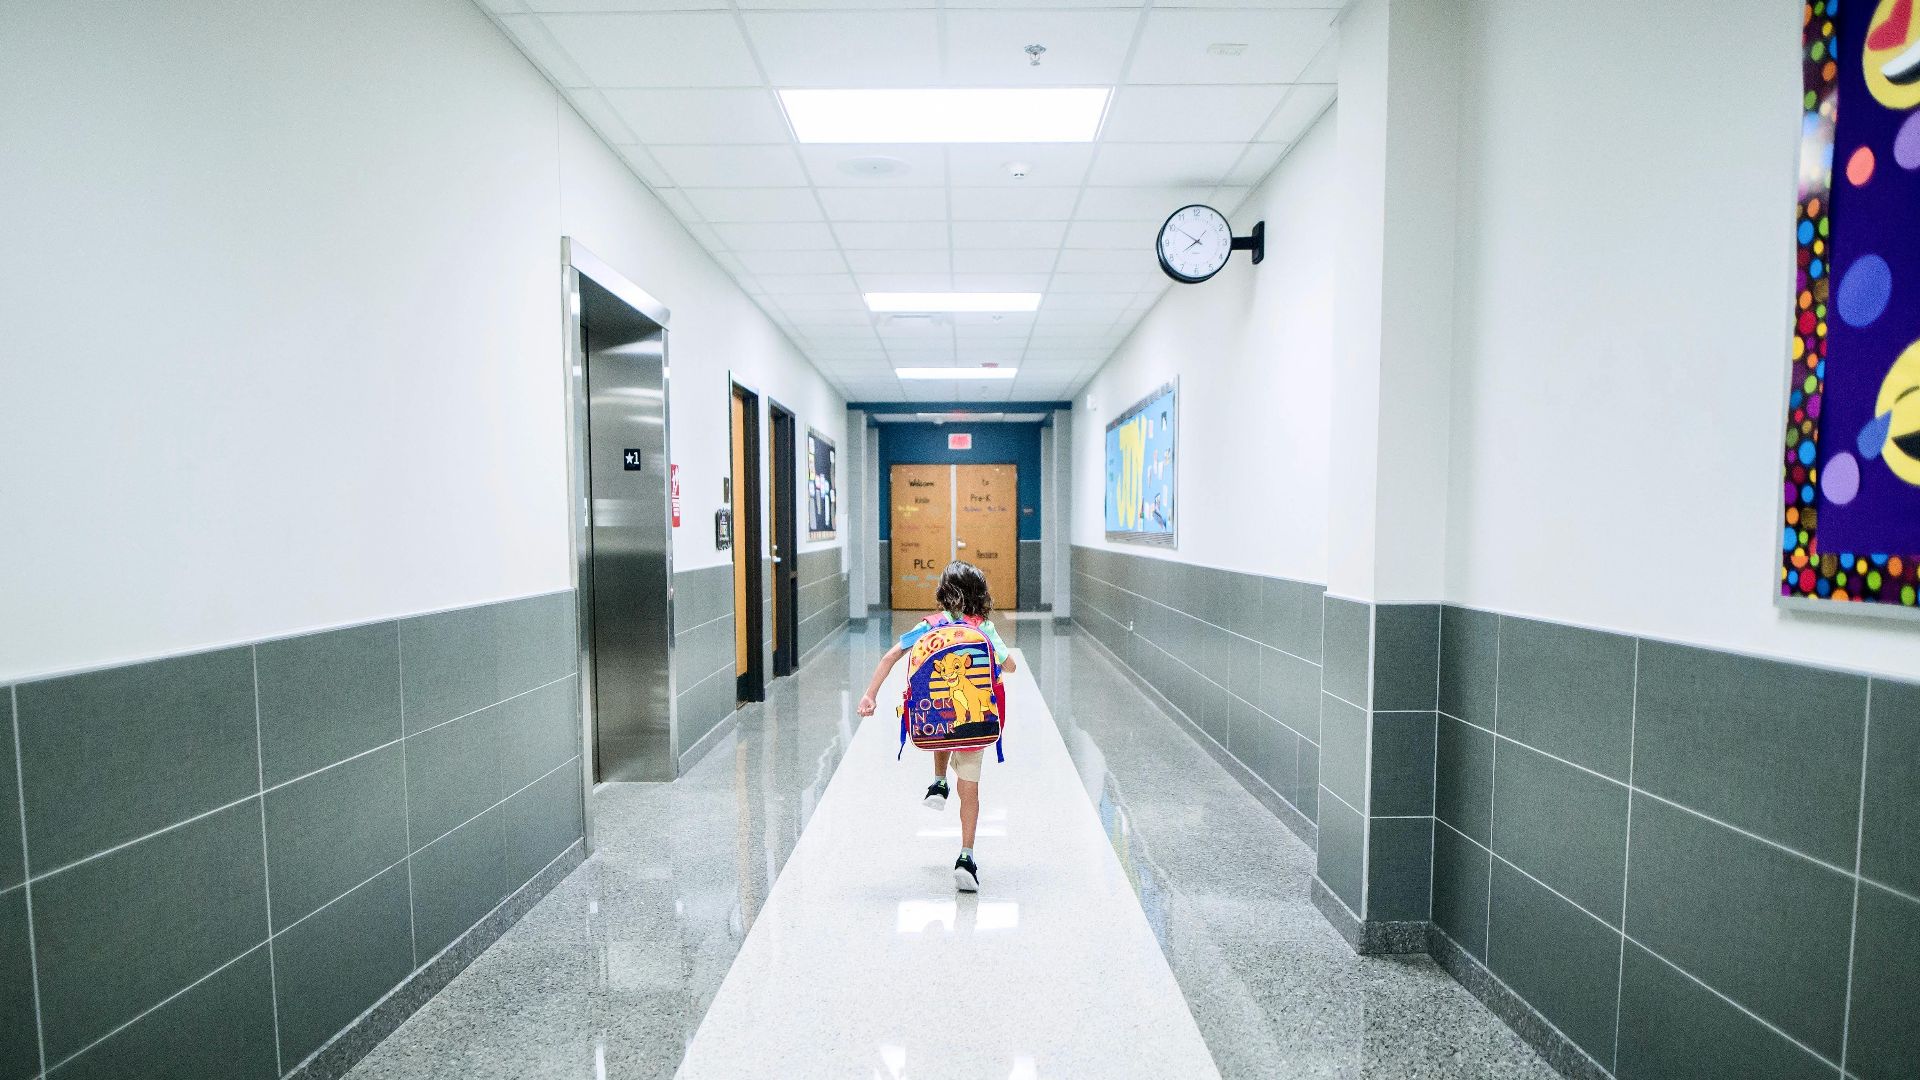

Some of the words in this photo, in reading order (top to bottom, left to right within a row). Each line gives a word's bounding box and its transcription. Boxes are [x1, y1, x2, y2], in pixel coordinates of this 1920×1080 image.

[1178, 213, 1185, 221] 11
[1193, 208, 1200, 217] 12
[1168, 223, 1176, 232] 10
[1218, 223, 1224, 232] 2
[1165, 239, 1170, 247] 9
[1222, 238, 1228, 246] 3
[1169, 253, 1175, 262] 8
[1218, 252, 1223, 260] 4
[1180, 263, 1185, 272] 7
[1193, 267, 1199, 275] 6
[634, 451, 640, 465] 1
[970, 493, 992, 502] Pre-K
[913, 559, 935, 569] PLC
[912, 722, 955, 736] ROAR
